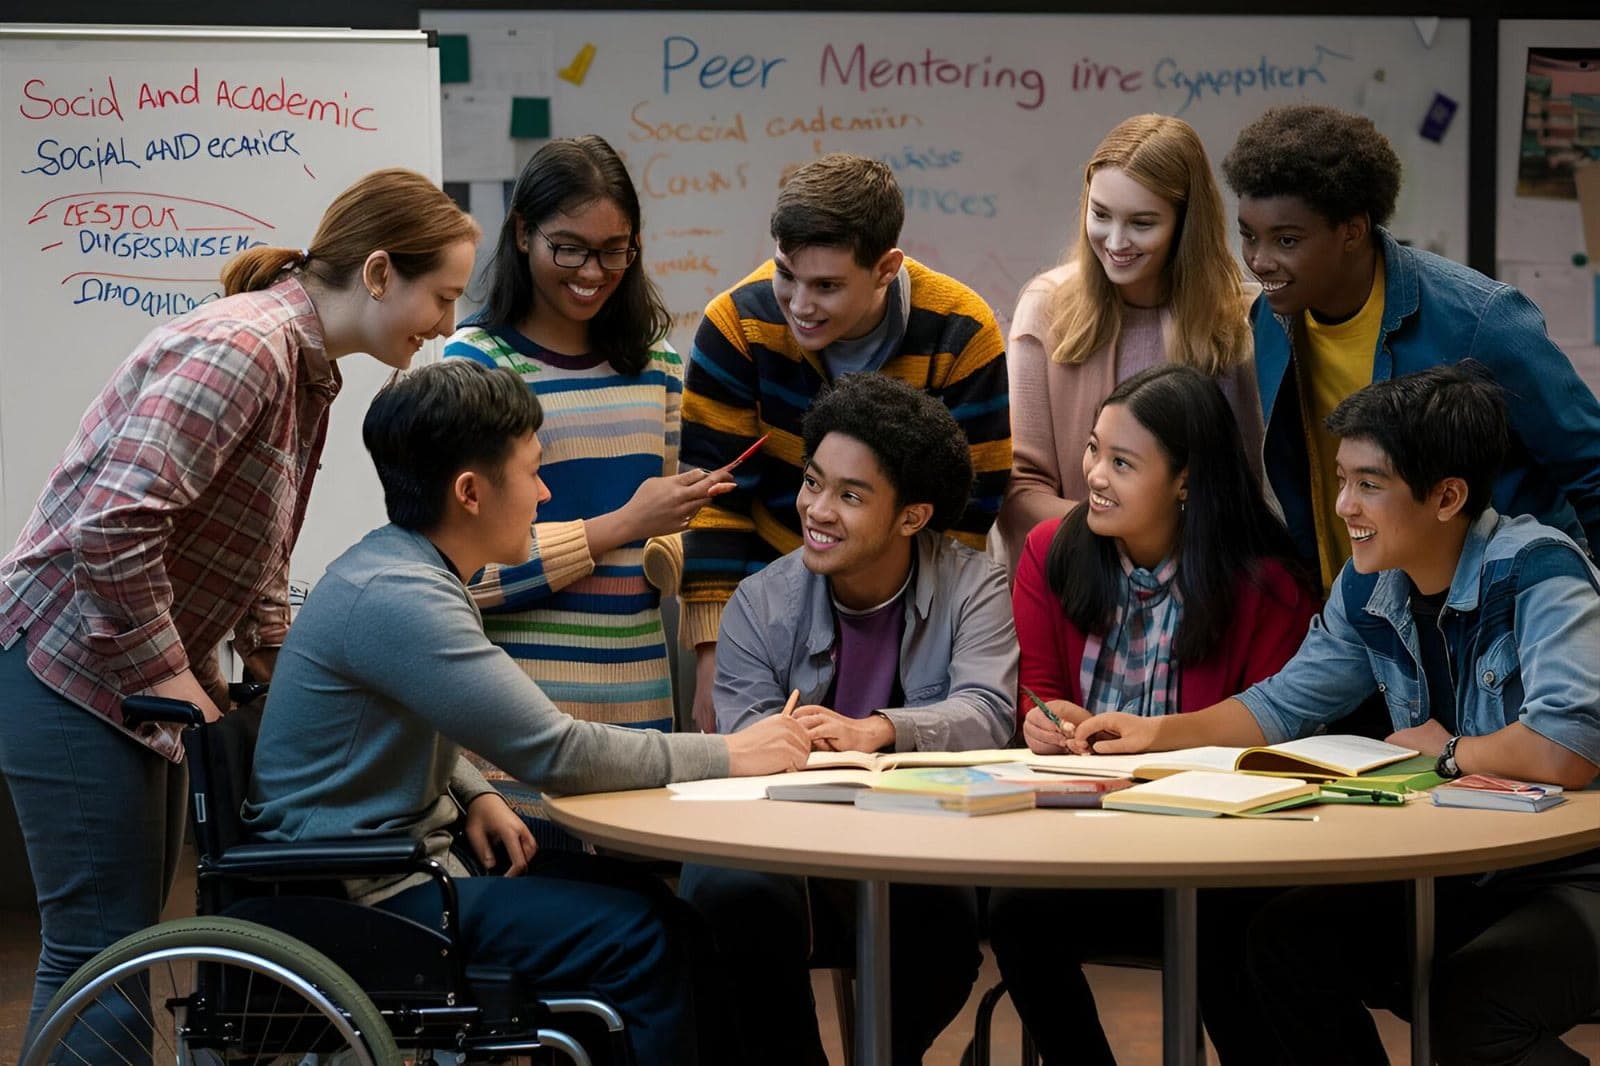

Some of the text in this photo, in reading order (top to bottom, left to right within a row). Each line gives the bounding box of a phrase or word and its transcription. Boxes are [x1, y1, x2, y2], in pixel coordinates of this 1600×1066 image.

[138, 67, 200, 110] And
[662, 36, 786, 95] Peer
[819, 43, 1046, 110] Mentoring
